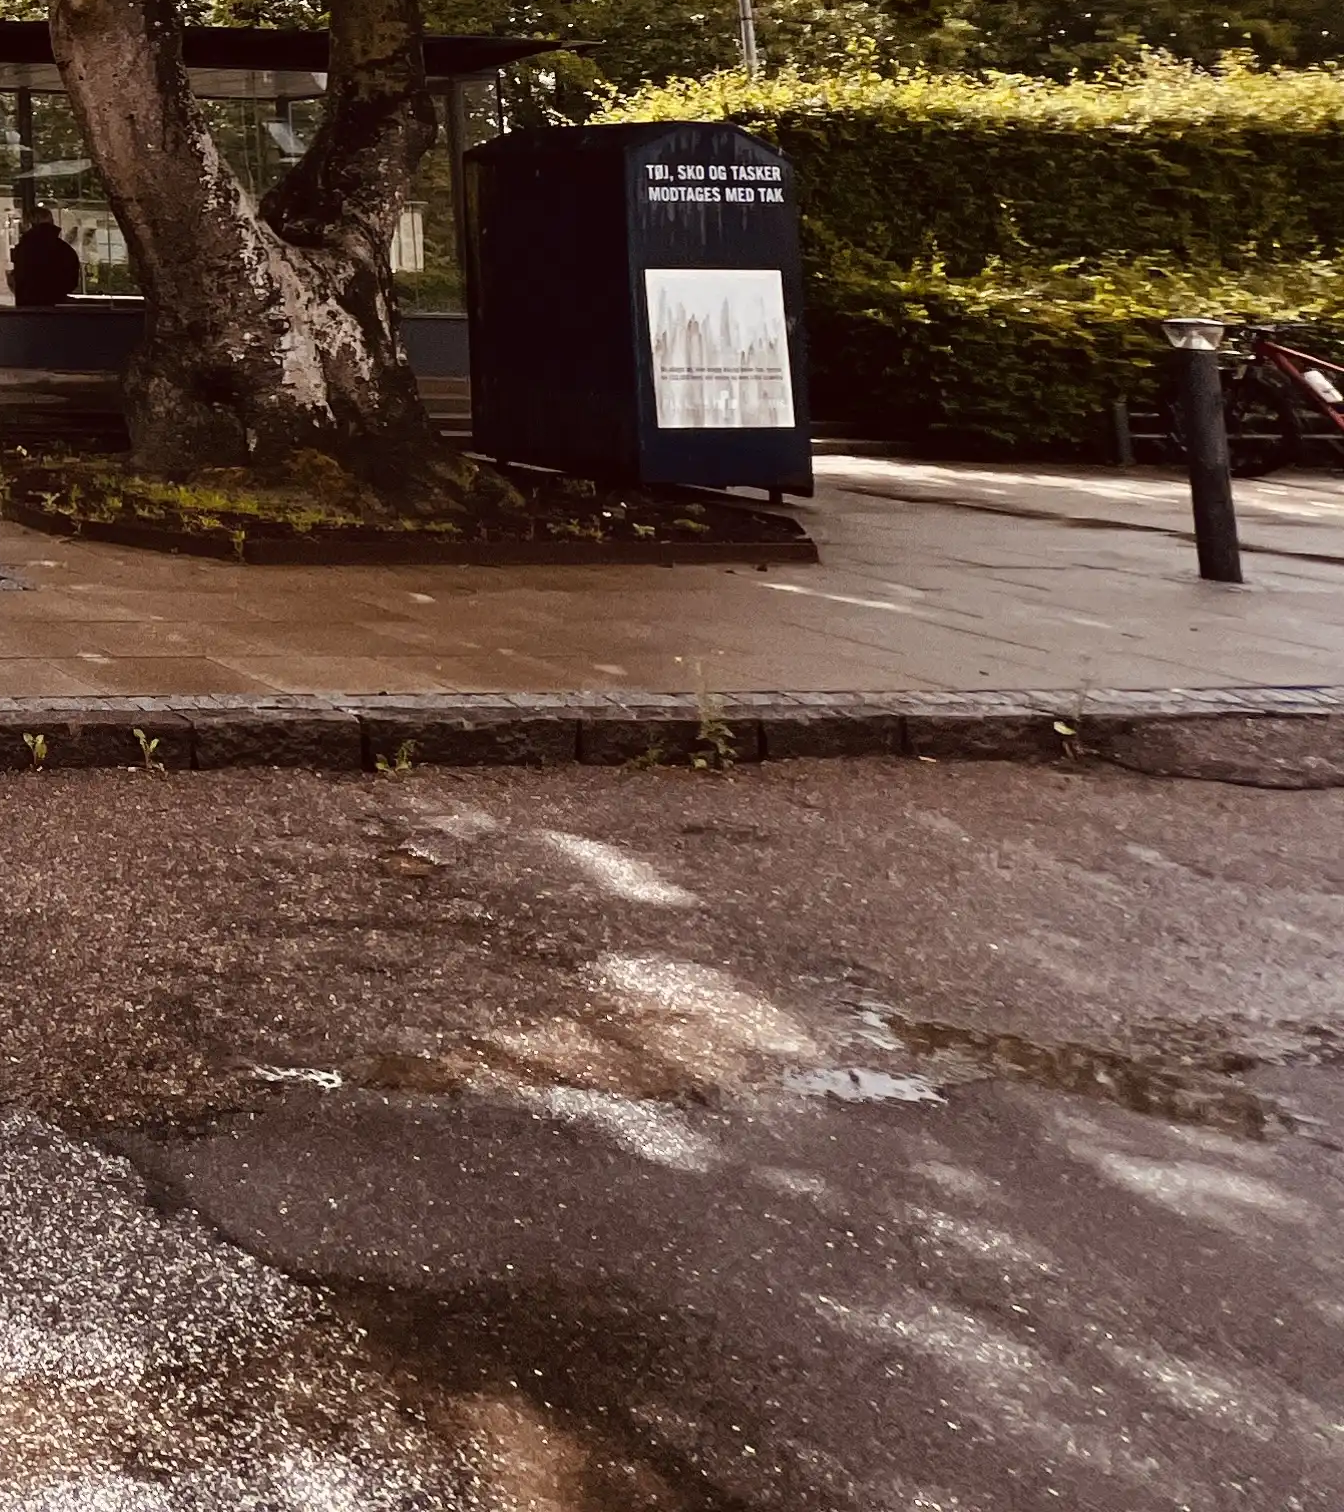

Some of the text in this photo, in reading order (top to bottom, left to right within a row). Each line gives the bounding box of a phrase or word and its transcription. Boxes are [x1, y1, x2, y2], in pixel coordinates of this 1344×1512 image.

[646, 164, 781, 181] TØJ, SKO OG TASKER
[648, 187, 784, 203] MODTAGES MED TAK
